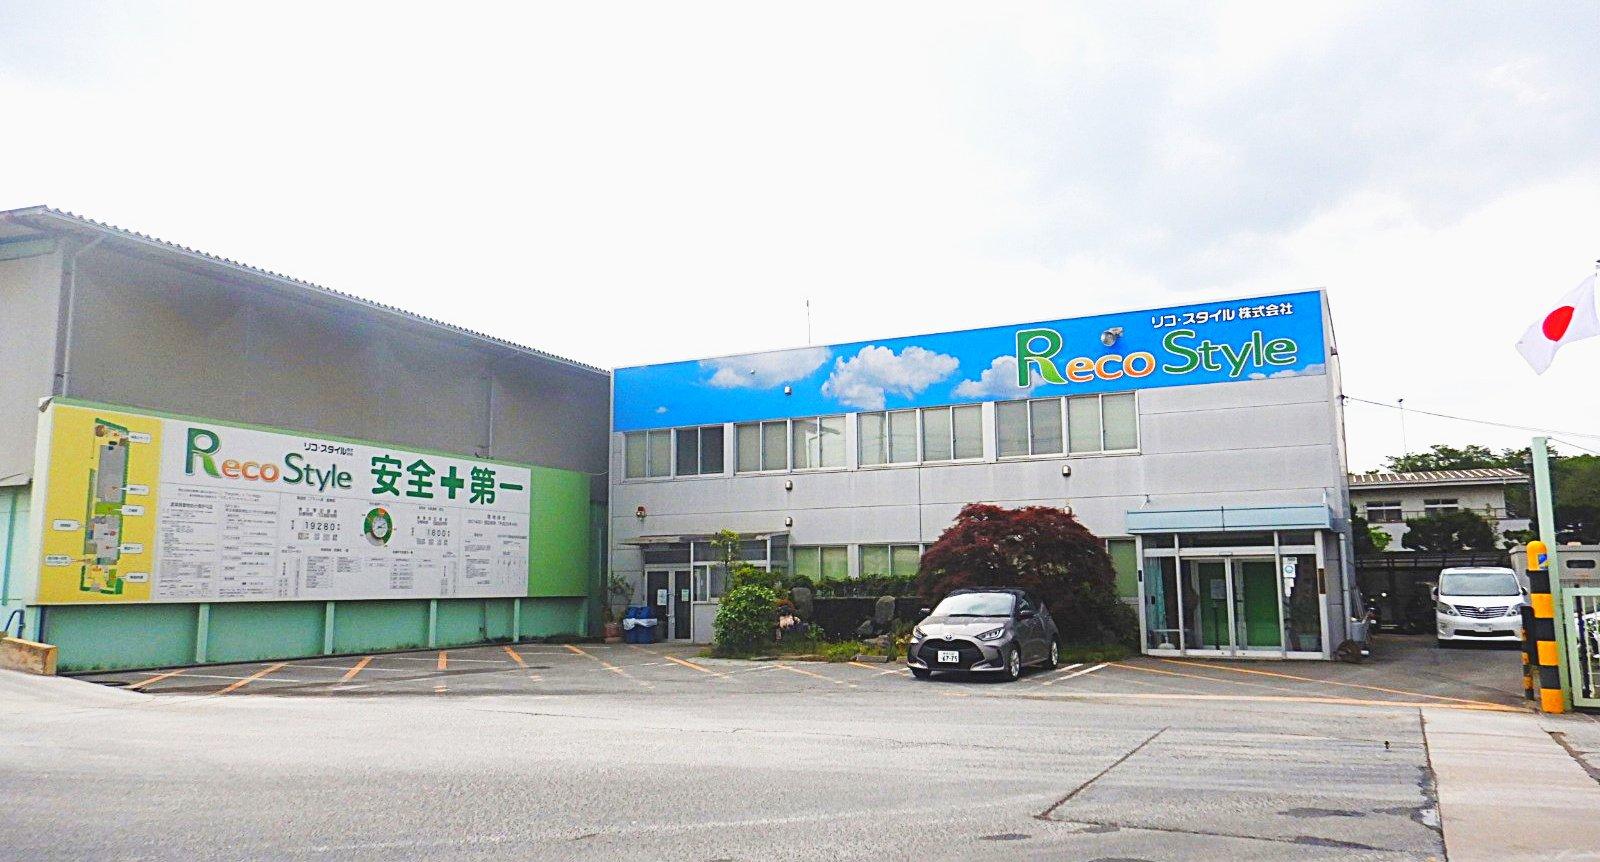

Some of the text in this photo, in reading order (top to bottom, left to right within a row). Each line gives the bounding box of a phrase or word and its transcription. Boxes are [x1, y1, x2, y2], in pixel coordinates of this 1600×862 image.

[1151, 302, 1293, 328] リコ・スタイル 株式会社
[1016, 327, 1297, 387] Reco Style
[185, 427, 353, 492] Reco Style
